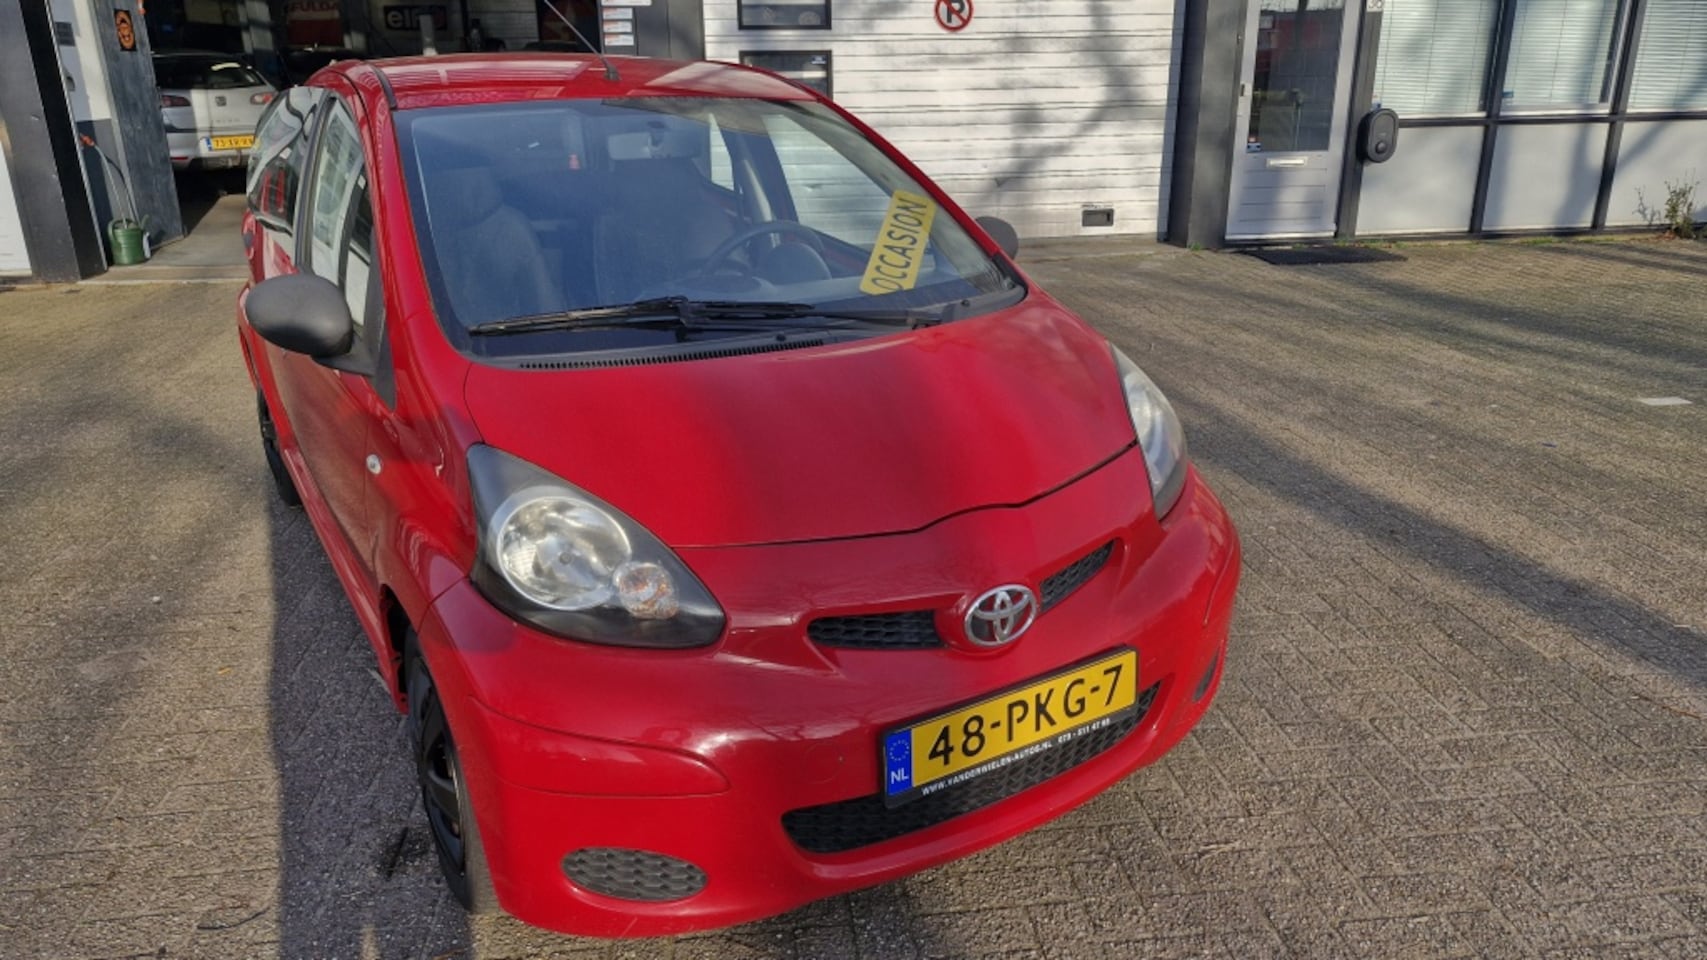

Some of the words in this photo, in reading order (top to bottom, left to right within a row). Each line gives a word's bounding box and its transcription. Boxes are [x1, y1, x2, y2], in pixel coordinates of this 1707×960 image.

[871, 197, 927, 291] OCCASION
[928, 664, 1123, 766] 48-PKG-7
[890, 767, 909, 785] NL
